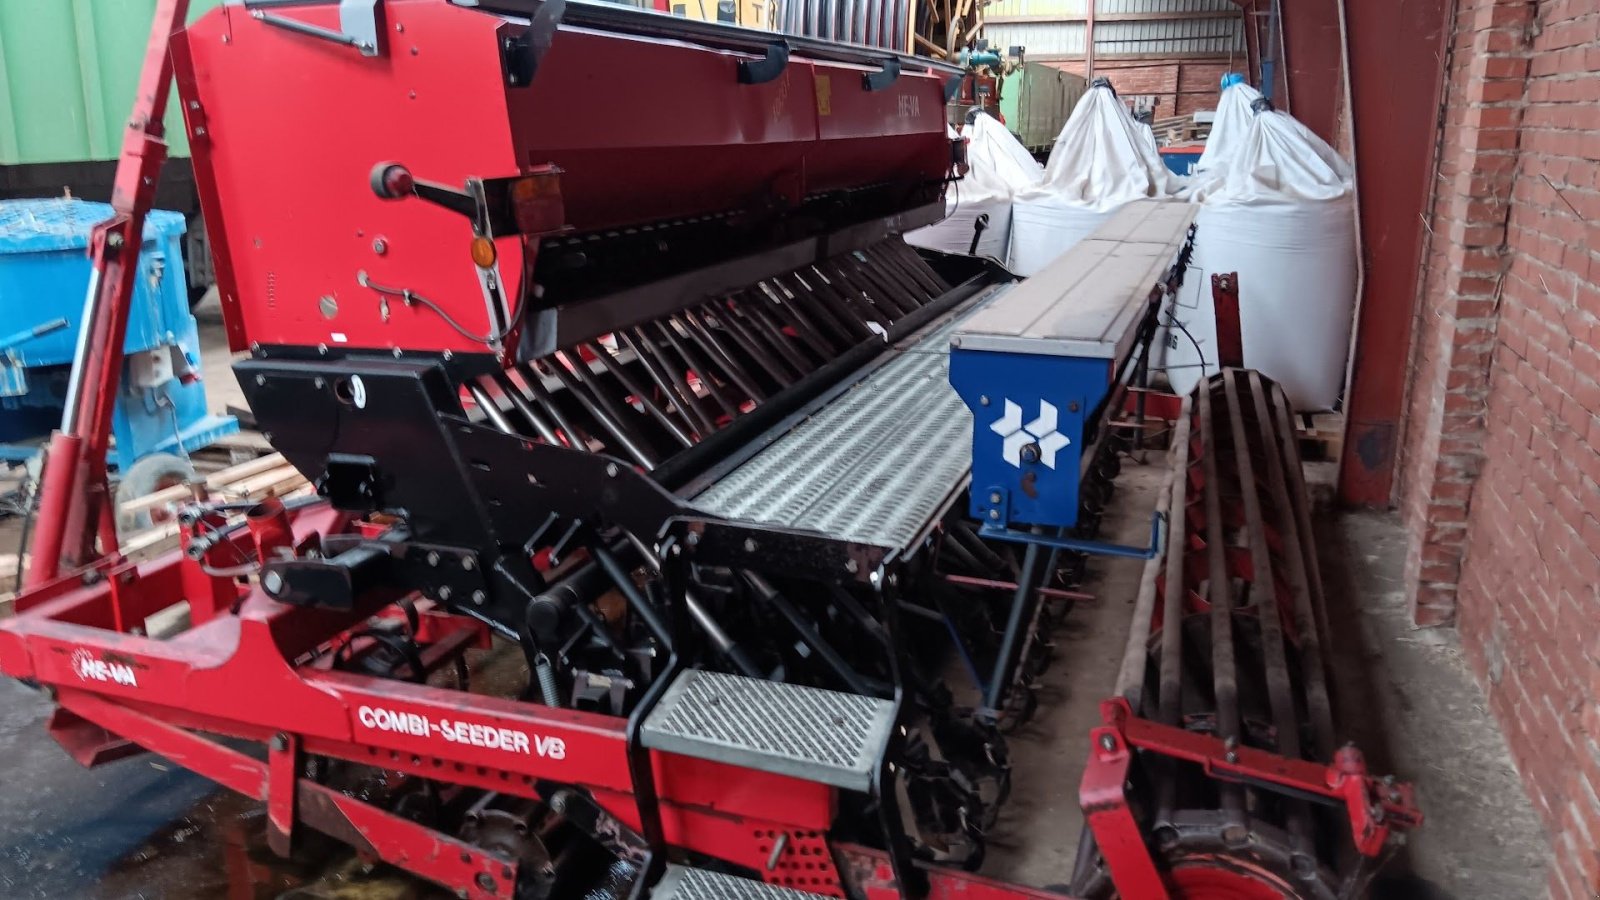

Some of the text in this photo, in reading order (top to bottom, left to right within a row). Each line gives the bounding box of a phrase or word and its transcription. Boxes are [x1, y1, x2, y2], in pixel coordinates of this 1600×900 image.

[898, 94, 920, 118] HE-VA
[79, 656, 138, 687] HE-VA
[358, 705, 531, 755] COMBI-SEEDER
